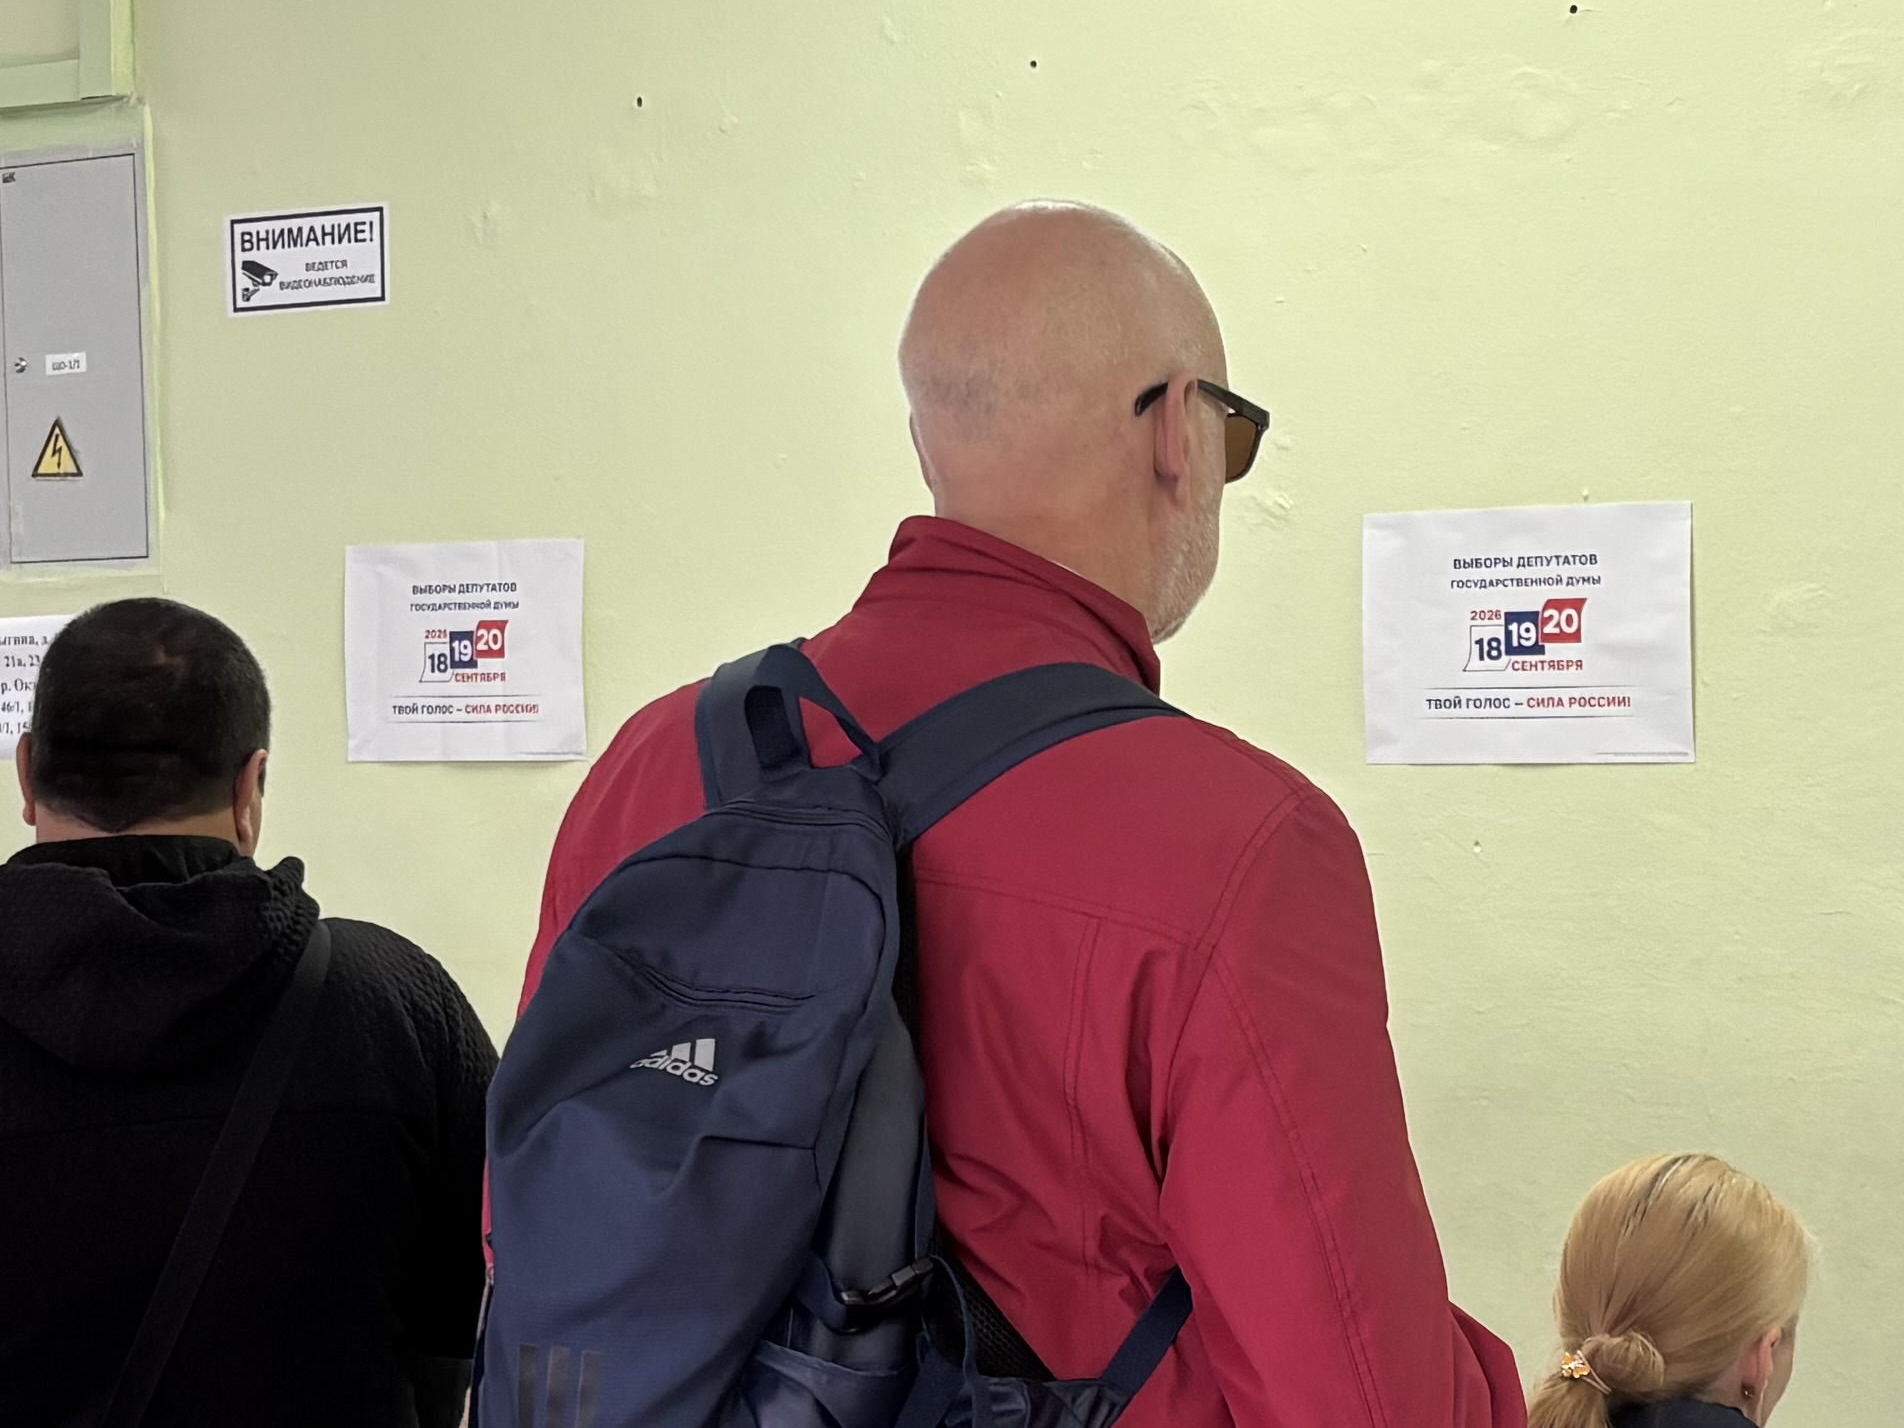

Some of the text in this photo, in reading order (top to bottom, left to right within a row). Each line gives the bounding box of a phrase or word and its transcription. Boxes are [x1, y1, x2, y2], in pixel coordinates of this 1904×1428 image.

[240, 220, 374, 253] ВНИМАНИЕ!
[1453, 554, 1598, 570] ВЫБОРЫ ДЕПУТАТОВ
[412, 582, 517, 595] ВЫБОРЫ ДЕПУТАТОВ
[1450, 575, 1602, 589] ГОСУДАРСТВЕННОЙ ДУМЫ
[1474, 608, 1579, 662] 18 19 20
[428, 628, 503, 674] 18 19 20
[1511, 659, 1583, 672] СЕНТЯБРЯ
[454, 672, 506, 683] СЕНТЯБРЯ
[392, 703, 419, 715] ТВОЙ
[421, 704, 454, 715] ГОЛОС
[465, 704, 492, 715] СИЛА
[1426, 696, 1462, 710] ТВОЙ
[1466, 697, 1511, 709] ГОЛОС
[1527, 697, 1564, 708] СИЛА
[1568, 696, 1631, 708] РОССИИ!
[629, 1055, 719, 1086] adidas
